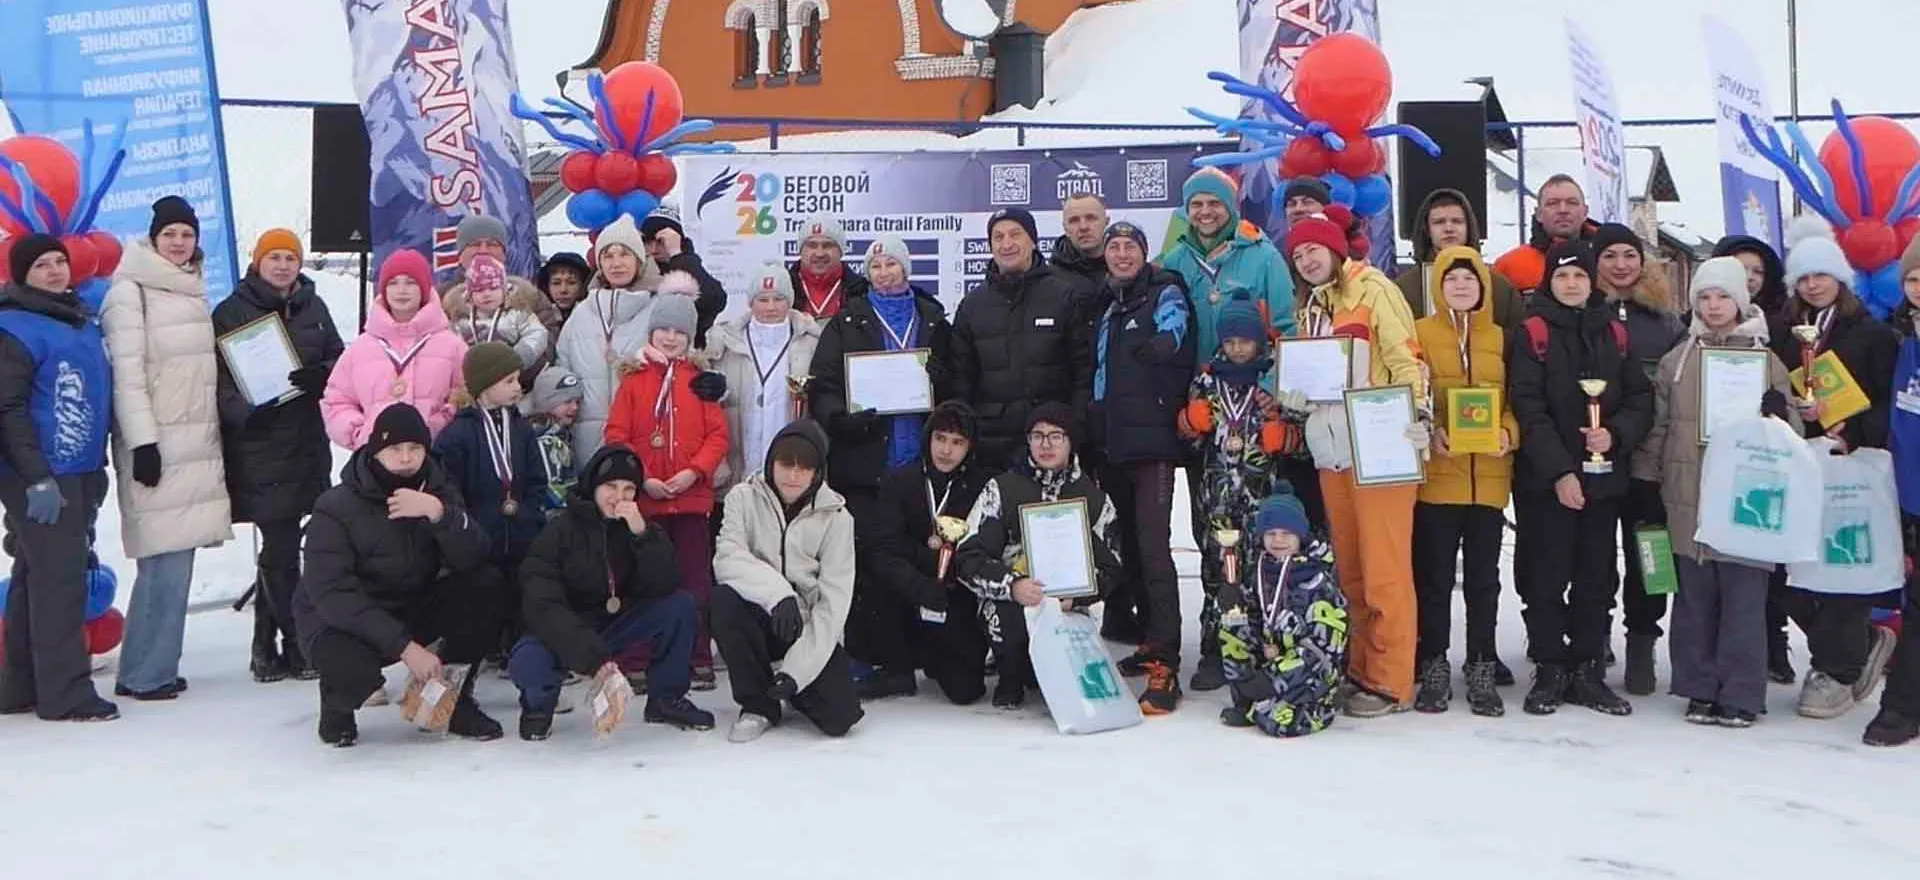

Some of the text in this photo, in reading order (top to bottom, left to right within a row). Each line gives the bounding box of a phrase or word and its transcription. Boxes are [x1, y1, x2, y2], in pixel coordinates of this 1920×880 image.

[736, 172, 781, 203] 20
[783, 171, 870, 194] БЕГОВОЙ
[783, 195, 844, 213] СЕЗОН
[736, 206, 778, 235] 26
[874, 216, 913, 231] Gtrail
[916, 214, 962, 233] Family
